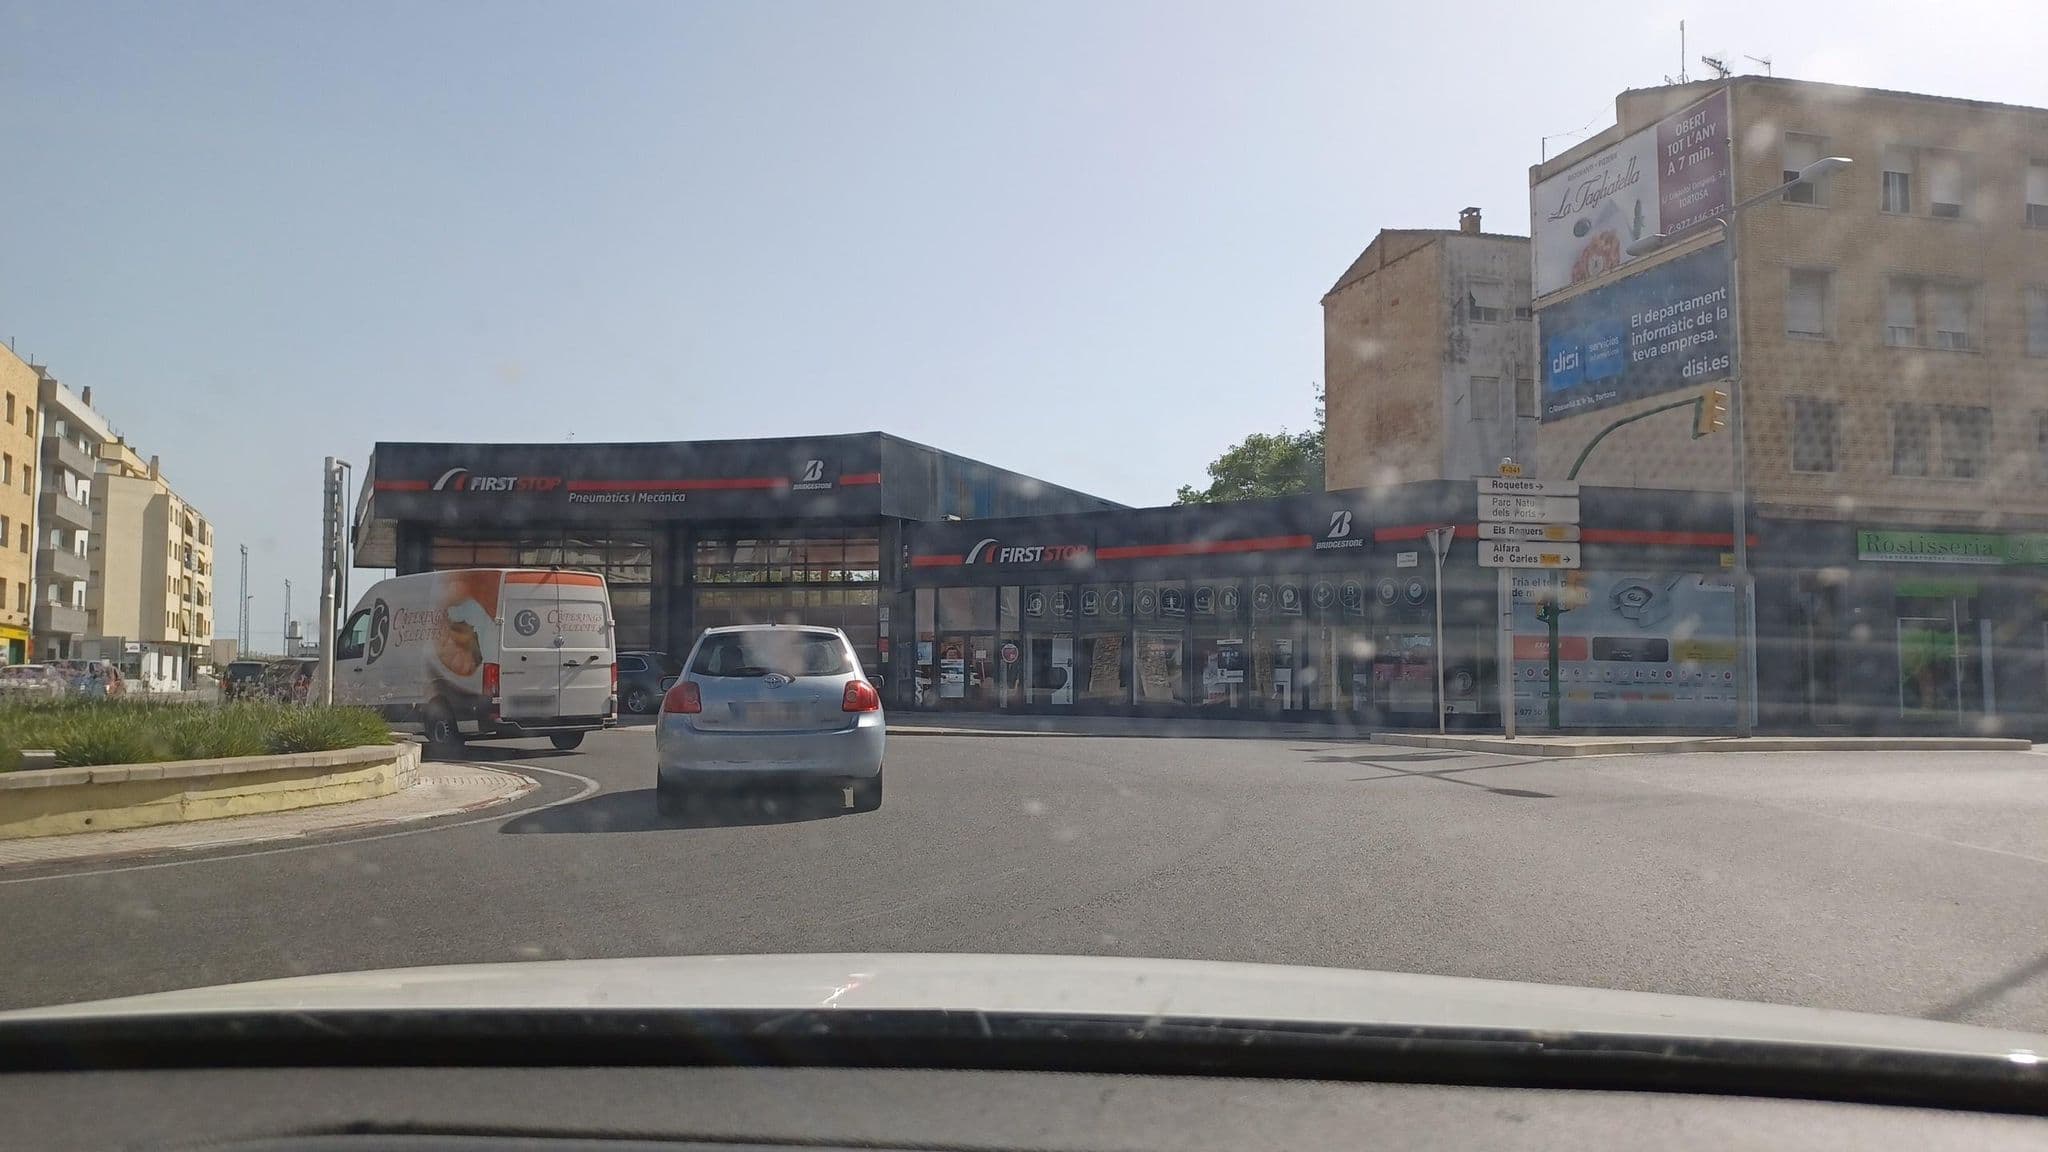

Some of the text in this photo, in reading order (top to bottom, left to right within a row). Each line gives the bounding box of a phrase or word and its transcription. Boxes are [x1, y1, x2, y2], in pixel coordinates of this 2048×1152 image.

[1675, 110, 1707, 136] OBERT
[1667, 122, 1717, 157] TOT L'ANY
[1667, 146, 1715, 176] A 7 min.
[1547, 187, 1572, 222] La
[1571, 155, 1641, 213] Tagliatella
[1631, 286, 1727, 328] El departament
[1631, 306, 1728, 347] informàtic de la
[1631, 346, 1658, 363] teva
[1658, 329, 1719, 354] empresa.
[1552, 346, 1580, 375] disi
[1681, 355, 1730, 378] disi.es
[793, 482, 832, 490] BRIDGESTONE
[1491, 480, 1534, 490] Roquetes
[1492, 497, 1511, 507] Parc
[1492, 509, 1510, 518] dels
[1492, 525, 1506, 535] Els
[1316, 538, 1364, 550] BRIDGESTONE
[1493, 543, 1520, 553] Alfara
[1864, 532, 1993, 555] Rostisseria
[1493, 554, 1504, 564] de
[1509, 554, 1538, 564] Carles
[1512, 577, 1530, 587] Tria
[1532, 577, 1541, 587] el
[1512, 588, 1524, 598] de
